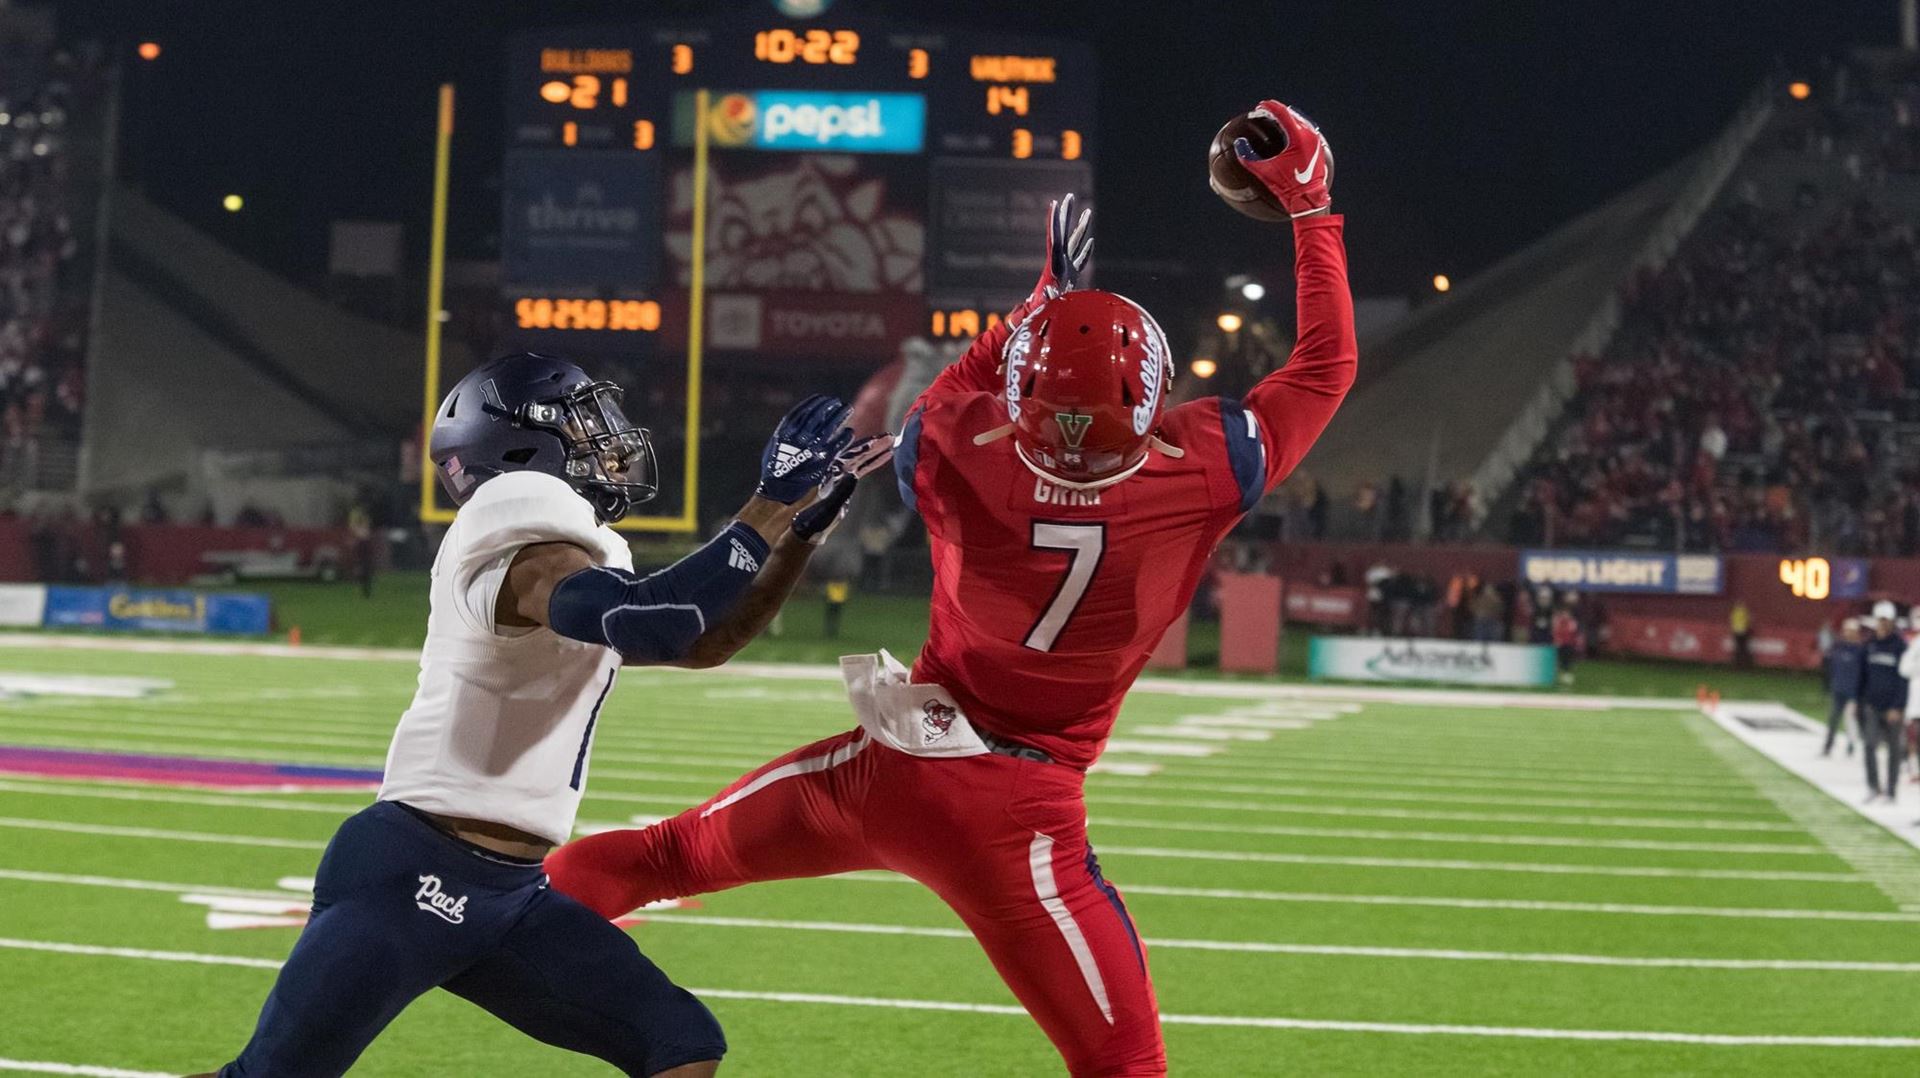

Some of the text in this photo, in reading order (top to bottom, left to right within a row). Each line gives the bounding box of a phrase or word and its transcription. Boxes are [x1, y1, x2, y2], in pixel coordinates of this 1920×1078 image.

[672, 44, 693, 75] 3
[755, 29, 860, 64] 10:22
[908, 48, 929, 79] 3
[569, 74, 628, 109] 21
[986, 86, 1029, 116] 14
[562, 121, 578, 147] 1
[633, 119, 655, 150] 3
[763, 98, 884, 143] pepsi
[1012, 128, 1033, 159] 3
[1061, 129, 1082, 160] 3
[770, 309, 886, 337] TOYOTA
[1006, 302, 1045, 422] lldogs
[1055, 411, 1092, 448] V
[773, 448, 814, 478] adidas
[1024, 520, 1105, 653] 7
[1525, 556, 1584, 584] BUD
[1586, 558, 1665, 587] LIGHT
[1778, 556, 1831, 600] 40
[415, 874, 469, 924] Pack
